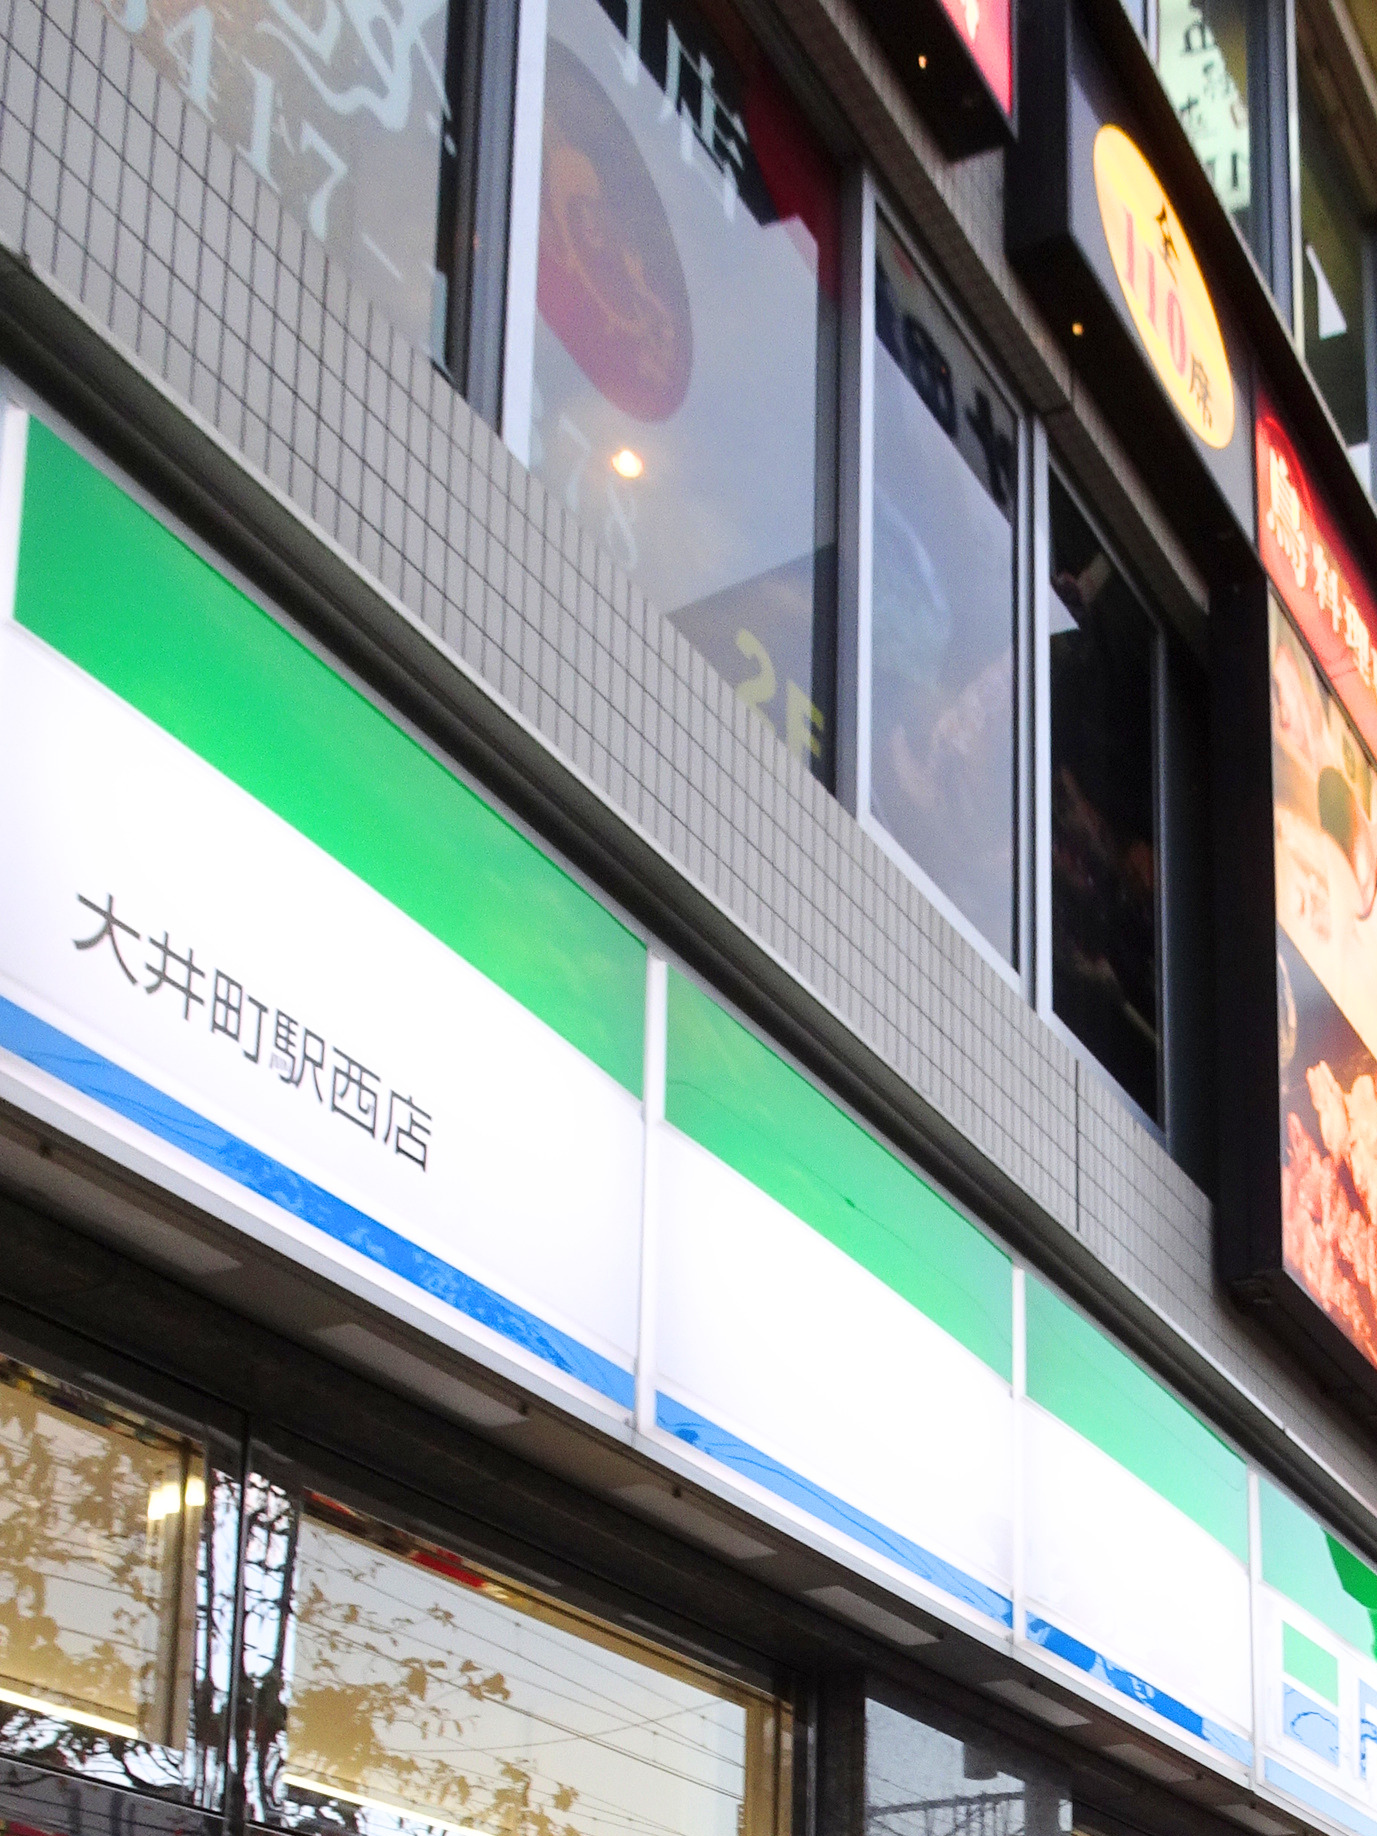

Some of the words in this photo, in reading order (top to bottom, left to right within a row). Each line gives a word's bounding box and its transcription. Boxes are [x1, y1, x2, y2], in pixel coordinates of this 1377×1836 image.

[73, 891, 434, 1173] 大井町駅西店
